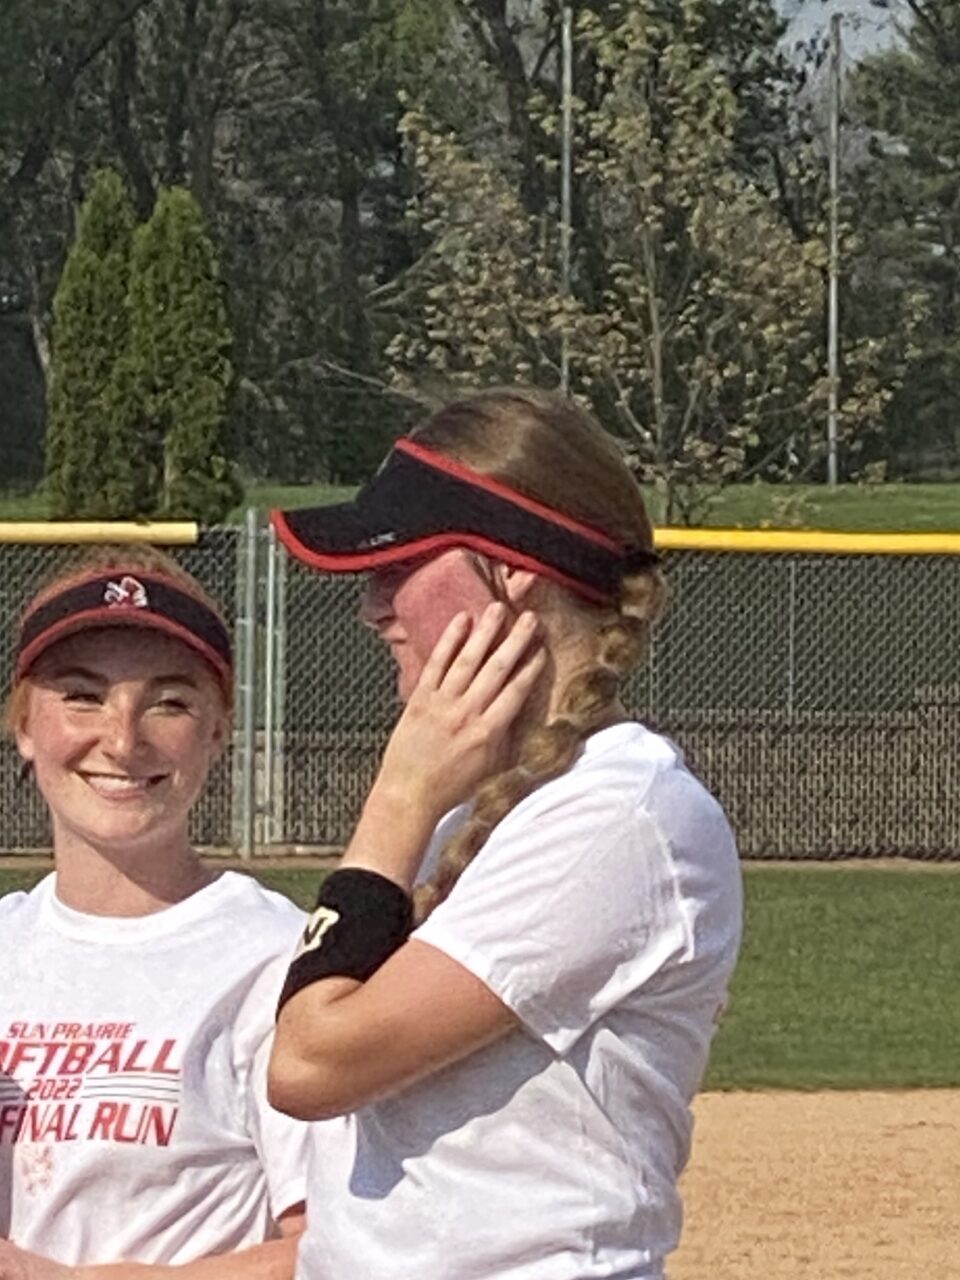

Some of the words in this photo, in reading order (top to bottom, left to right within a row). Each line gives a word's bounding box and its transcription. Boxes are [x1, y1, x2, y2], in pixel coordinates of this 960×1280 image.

[6, 1021, 47, 1039] SUN
[50, 1021, 136, 1040] PRAIRIE
[26, 1077, 83, 1101] 2022
[87, 1101, 179, 1147] RUN
